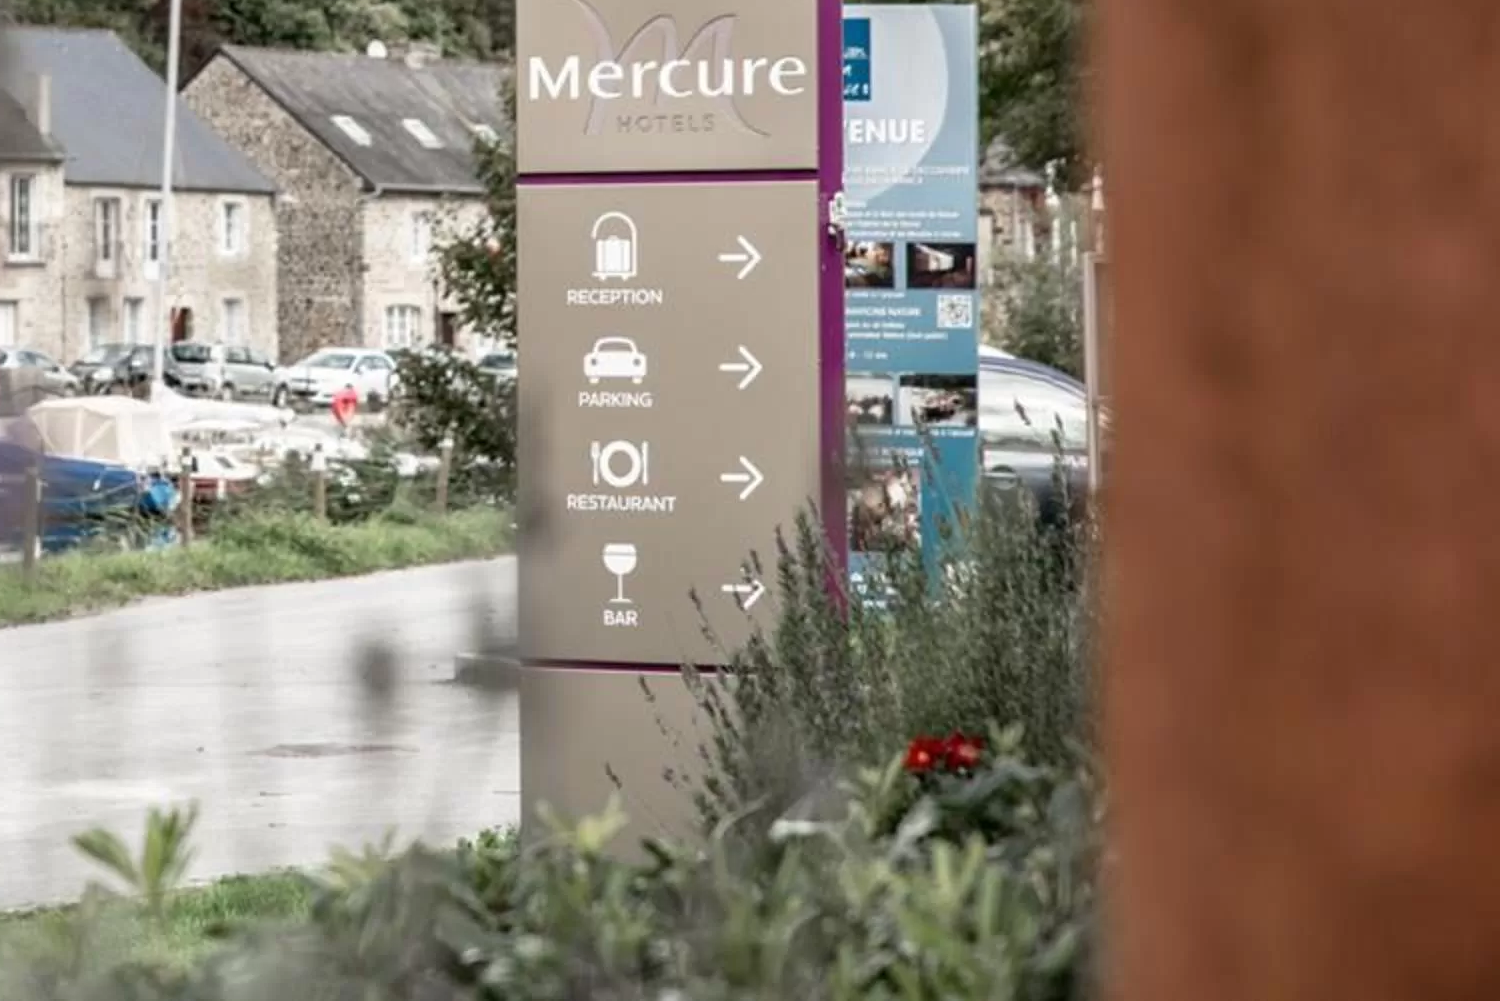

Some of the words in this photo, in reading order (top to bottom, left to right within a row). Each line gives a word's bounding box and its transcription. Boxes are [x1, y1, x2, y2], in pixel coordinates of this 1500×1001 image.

[528, 55, 806, 100] Mercure
[616, 113, 715, 134] HOTELS
[843, 118, 925, 144] ENUE
[567, 288, 663, 305] RECEPTION
[578, 391, 653, 408] PARKING
[567, 494, 677, 512] RESTAURANT
[603, 609, 638, 626] BAR
